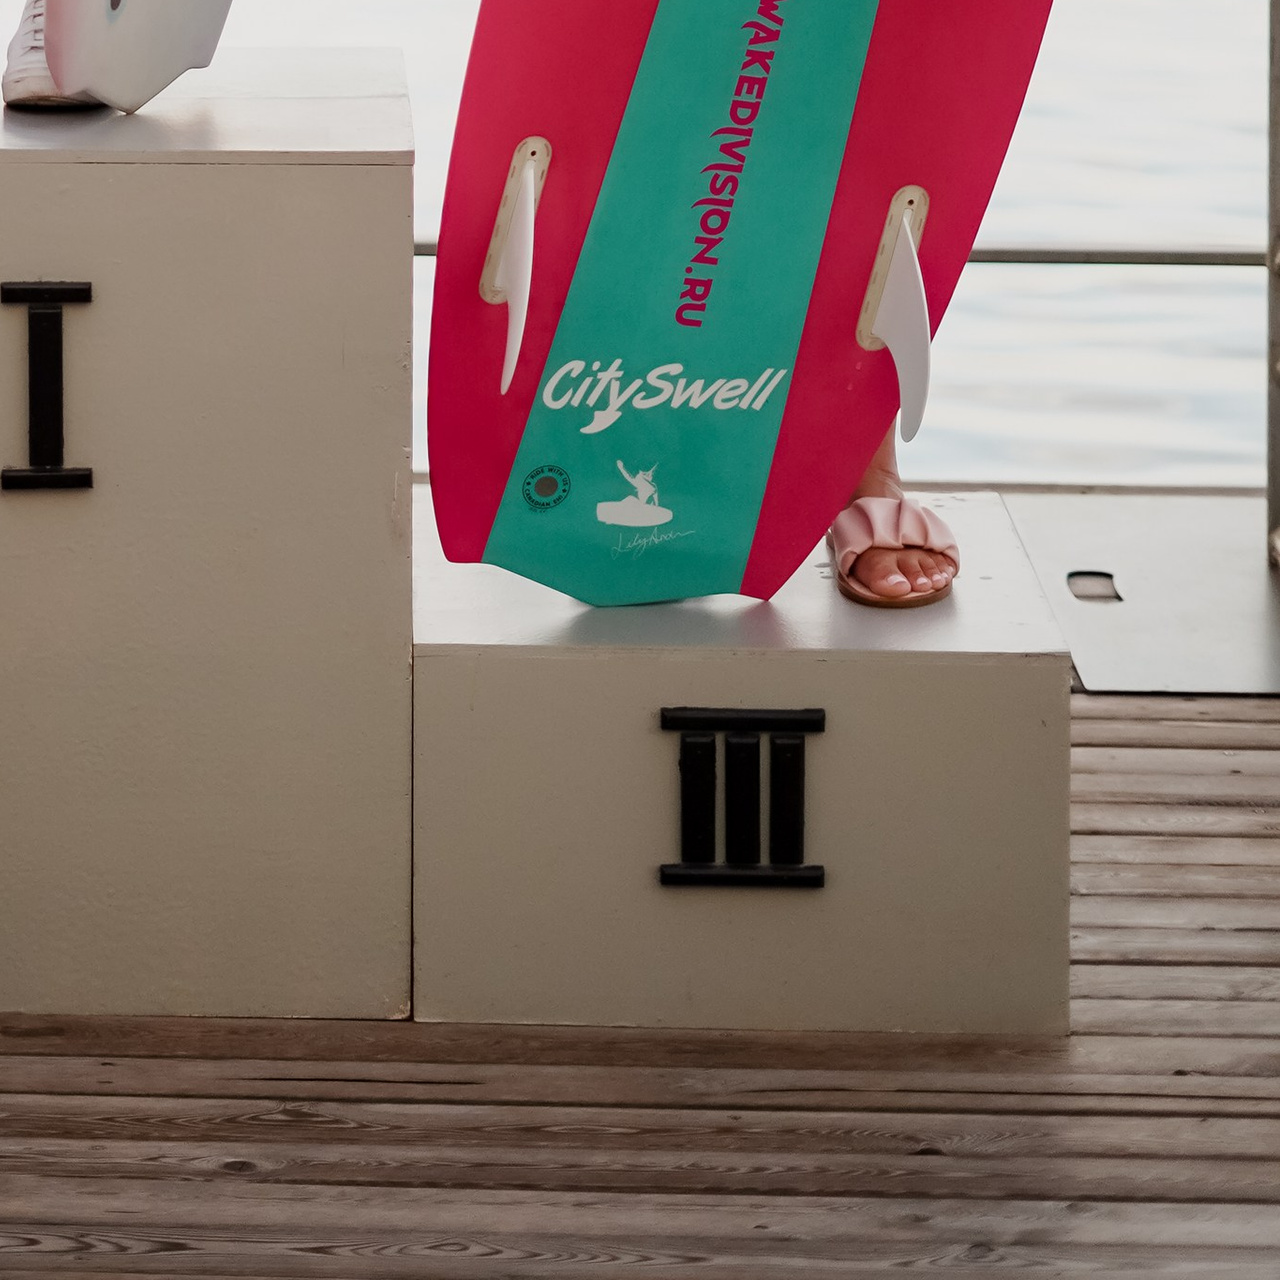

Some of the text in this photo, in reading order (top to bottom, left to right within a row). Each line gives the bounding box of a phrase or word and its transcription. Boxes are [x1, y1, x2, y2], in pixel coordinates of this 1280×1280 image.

[1, 282, 93, 489] I
[542, 358, 789, 434] CitySwell
[660, 706, 826, 888] III
